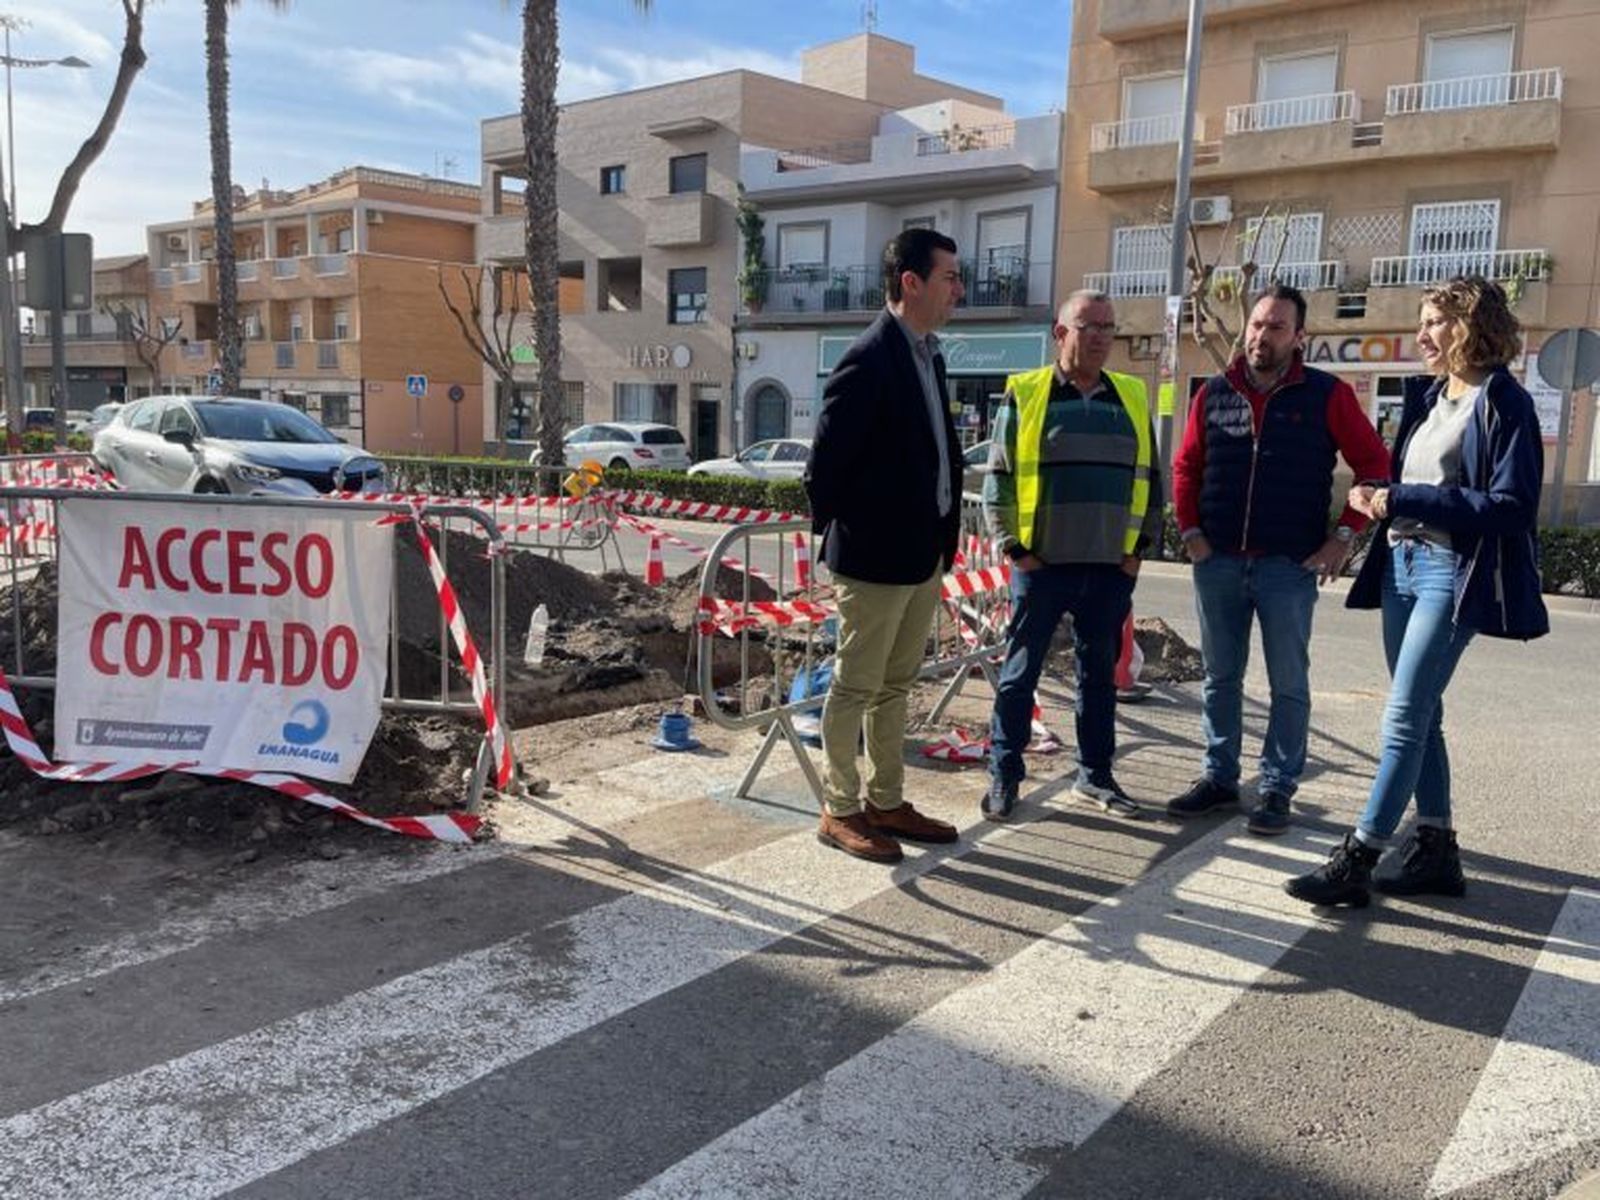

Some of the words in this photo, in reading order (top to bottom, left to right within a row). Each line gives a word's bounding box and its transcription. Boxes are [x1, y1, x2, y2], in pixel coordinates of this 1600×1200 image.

[627, 345, 691, 369] HARO
[118, 526, 335, 599] ACCESO
[89, 611, 359, 691] CORTADO
[257, 743, 339, 764] EMANAGUA
